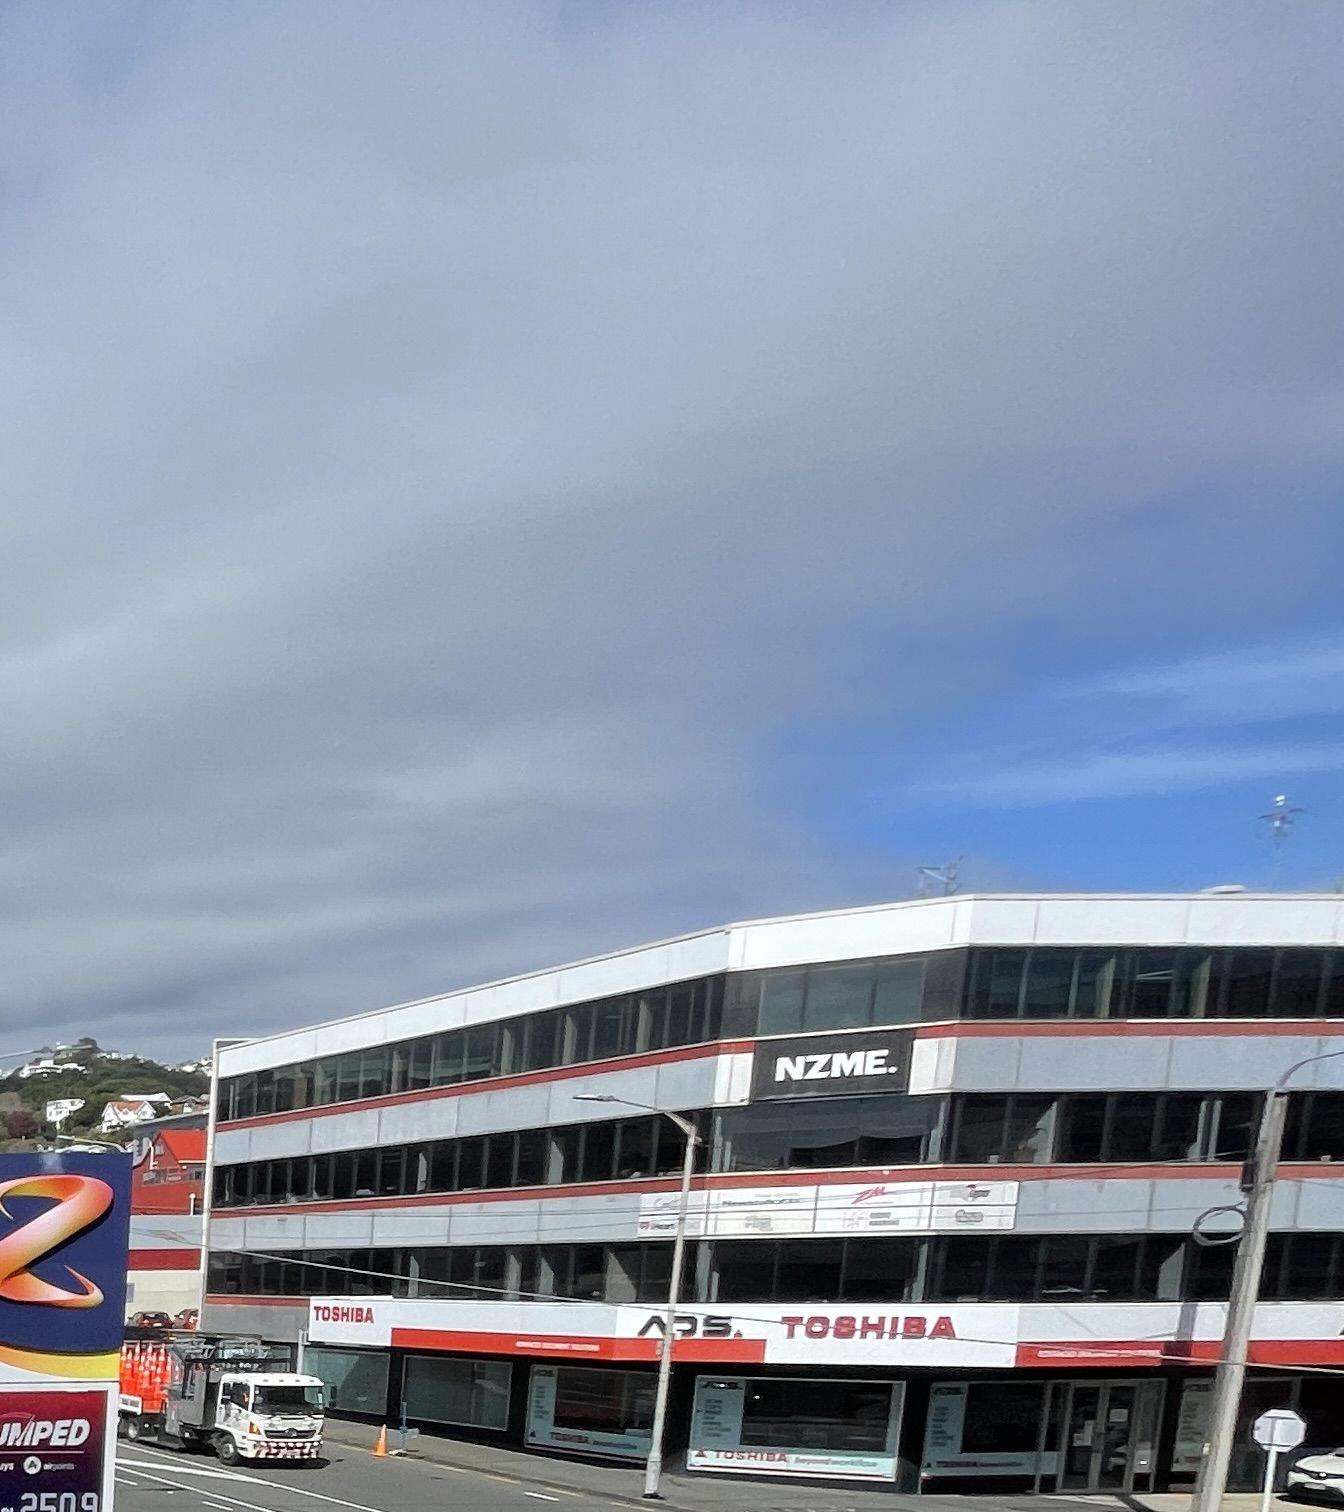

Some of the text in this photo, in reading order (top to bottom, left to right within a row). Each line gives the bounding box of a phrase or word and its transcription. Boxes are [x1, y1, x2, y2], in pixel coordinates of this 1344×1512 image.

[774, 1049, 898, 1082] NZME.
[313, 1305, 375, 1324] TOSHIBA
[781, 1315, 957, 1341] TOSHIBA
[715, 1448, 787, 1464] TOSHIBA
